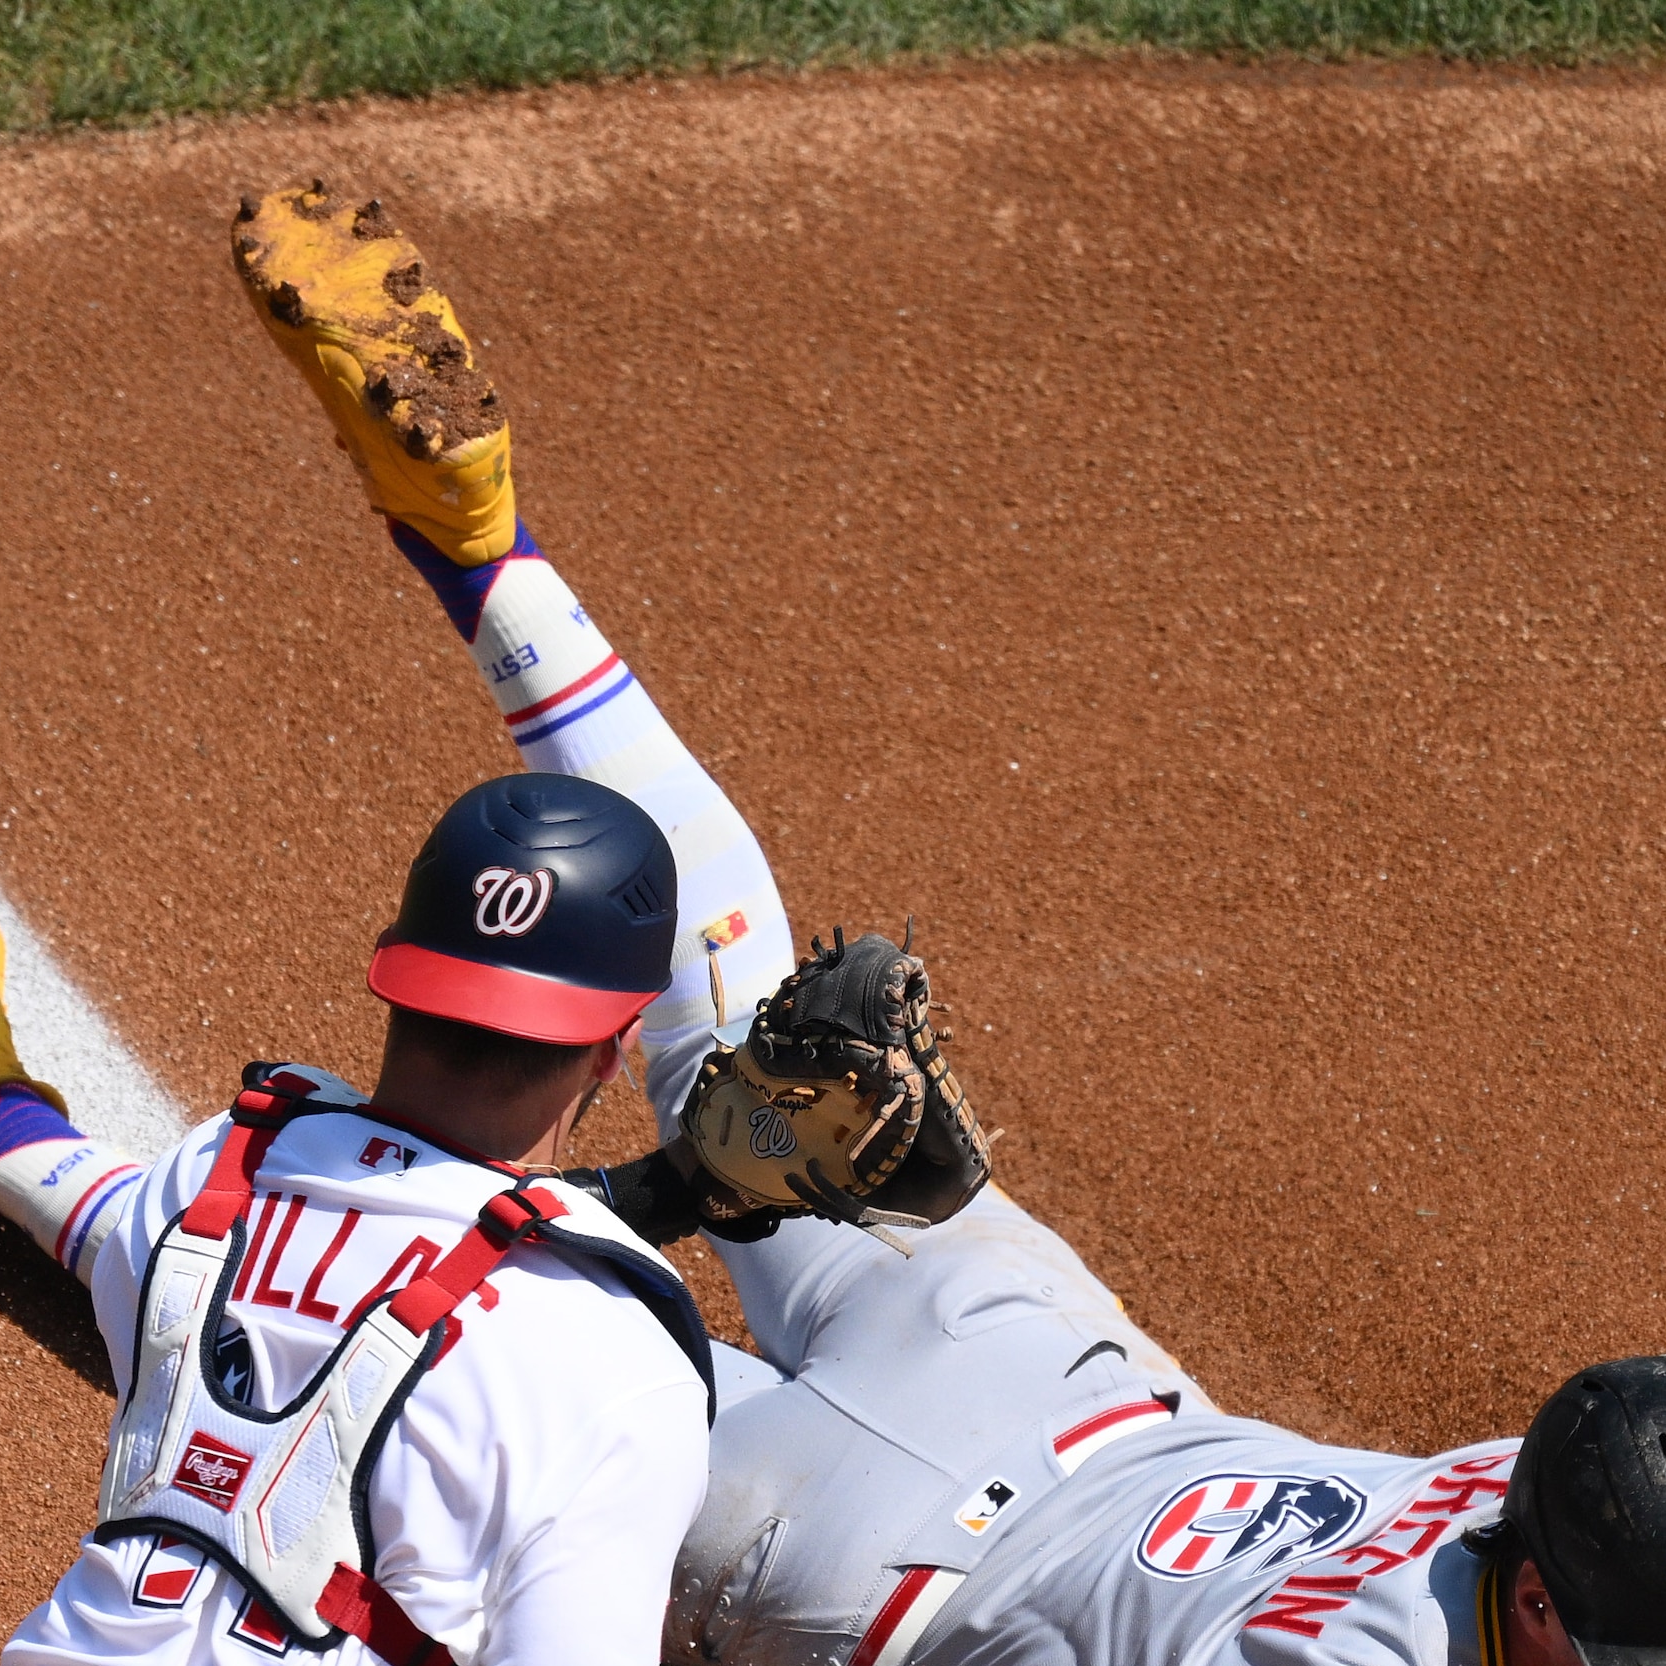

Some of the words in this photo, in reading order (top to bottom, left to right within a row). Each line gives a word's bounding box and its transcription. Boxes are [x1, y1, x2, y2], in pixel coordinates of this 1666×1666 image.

[483, 642, 540, 684] EST.
[473, 867, 553, 937] W
[749, 1105, 797, 1158] W
[40, 1148, 95, 1187] USA
[231, 1191, 500, 1370] ILLA
[185, 1450, 239, 1487] Rawlings
[1134, 1471, 1369, 1580] 6
